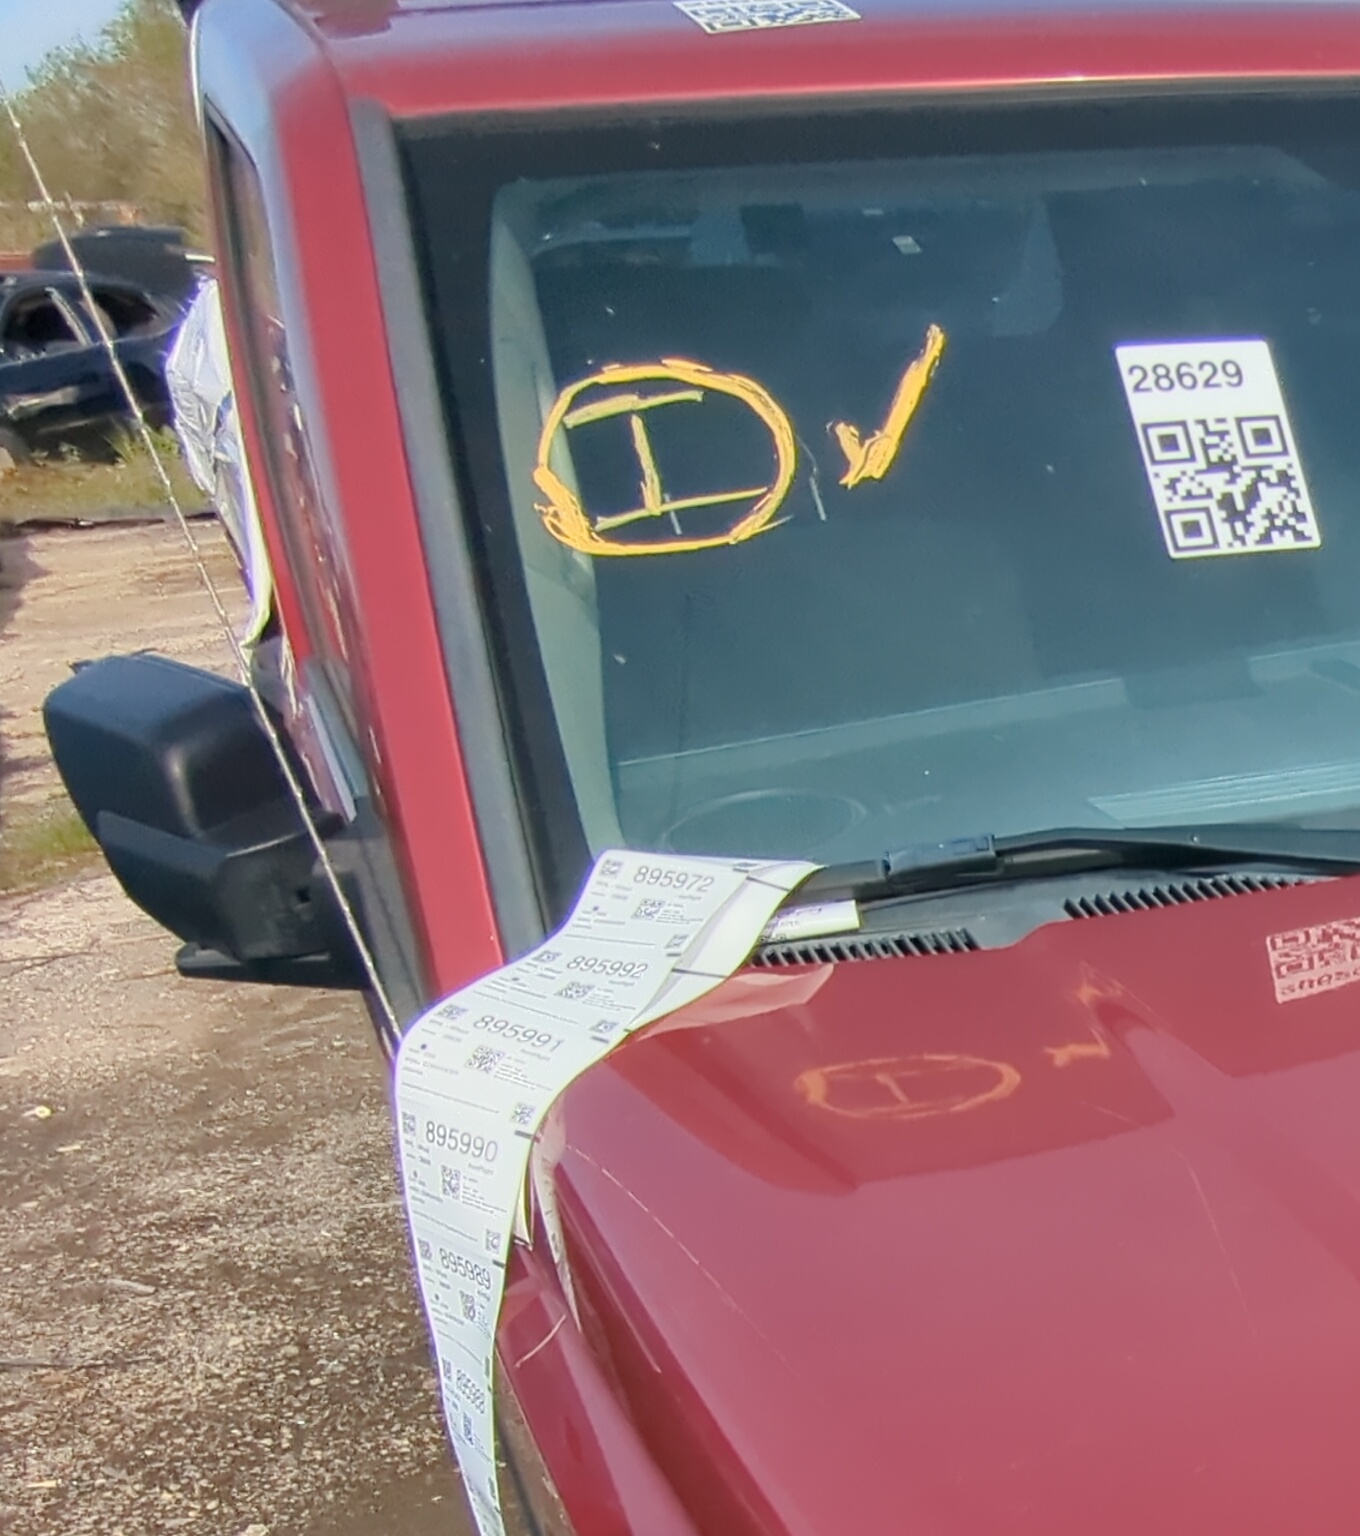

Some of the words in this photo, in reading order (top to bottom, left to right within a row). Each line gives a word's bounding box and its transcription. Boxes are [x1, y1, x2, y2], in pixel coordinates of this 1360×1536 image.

[1127, 359, 1244, 394] 28629
[633, 865, 715, 892] 895972
[566, 956, 649, 979] 895992
[473, 1015, 565, 1052] 895991
[425, 1120, 499, 1163] 895990
[439, 1247, 491, 1290] 895989
